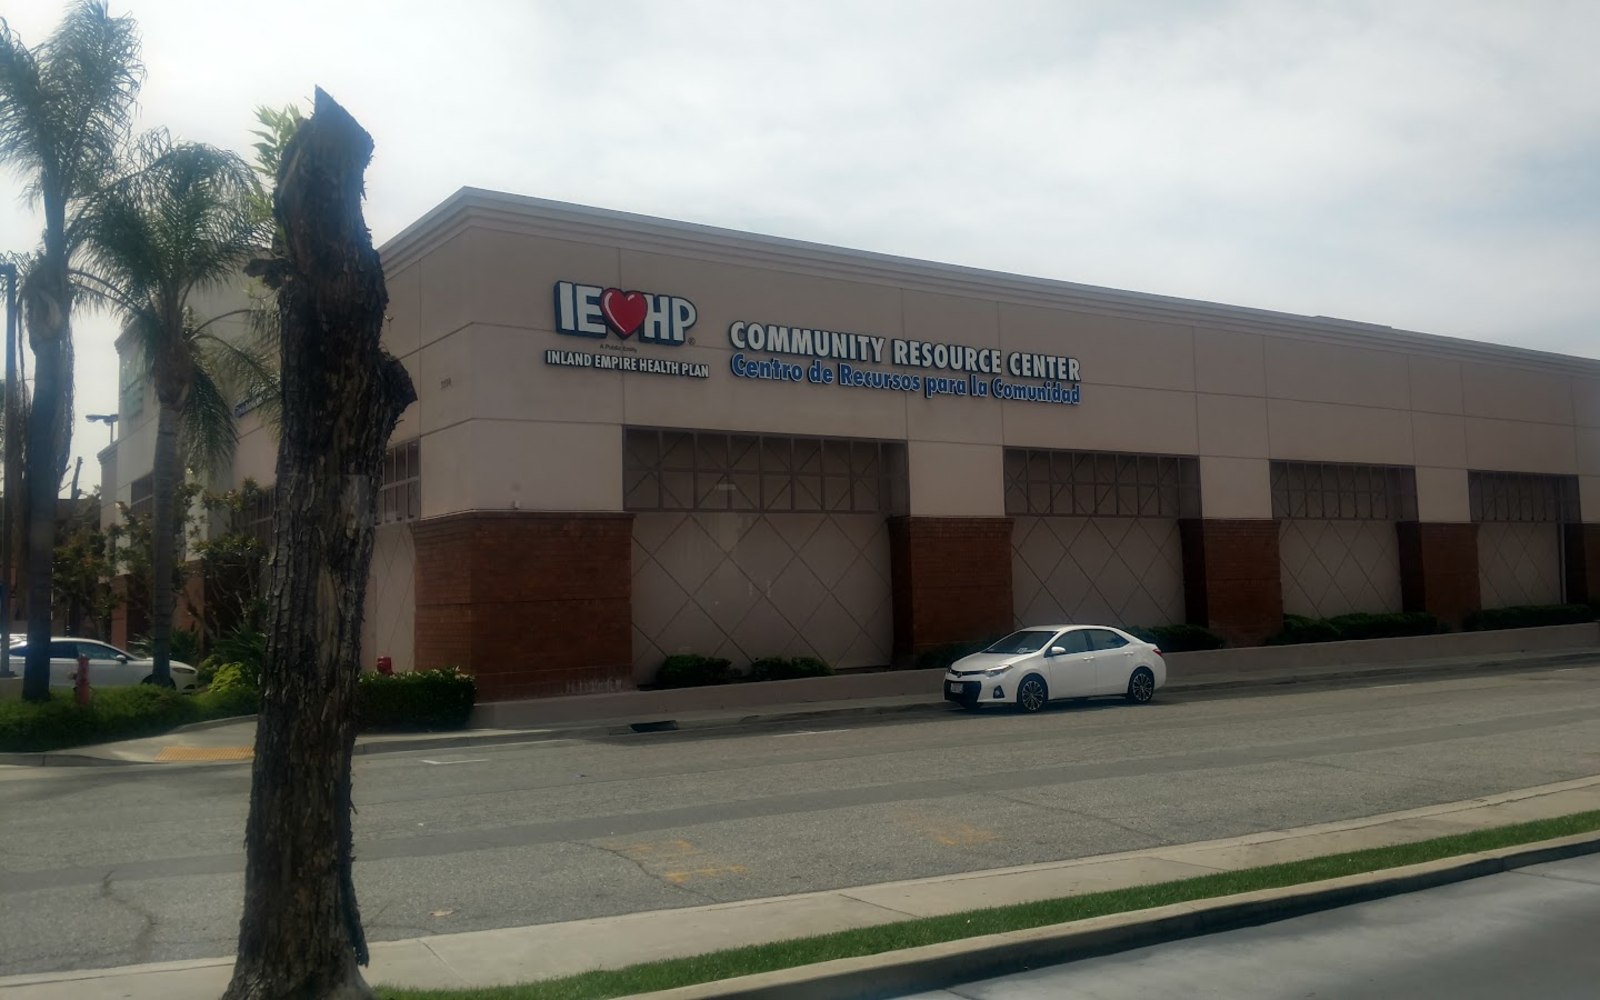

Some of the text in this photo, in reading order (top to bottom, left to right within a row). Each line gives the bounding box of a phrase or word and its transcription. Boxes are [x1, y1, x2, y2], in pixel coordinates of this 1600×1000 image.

[546, 350, 709, 378] INLAND EMPIRE HEALTH PLAN
[729, 320, 1081, 381] COMMUNITY RESOURCE CENTER
[731, 352, 1081, 405] Centro de Recursos para la Comunidad
